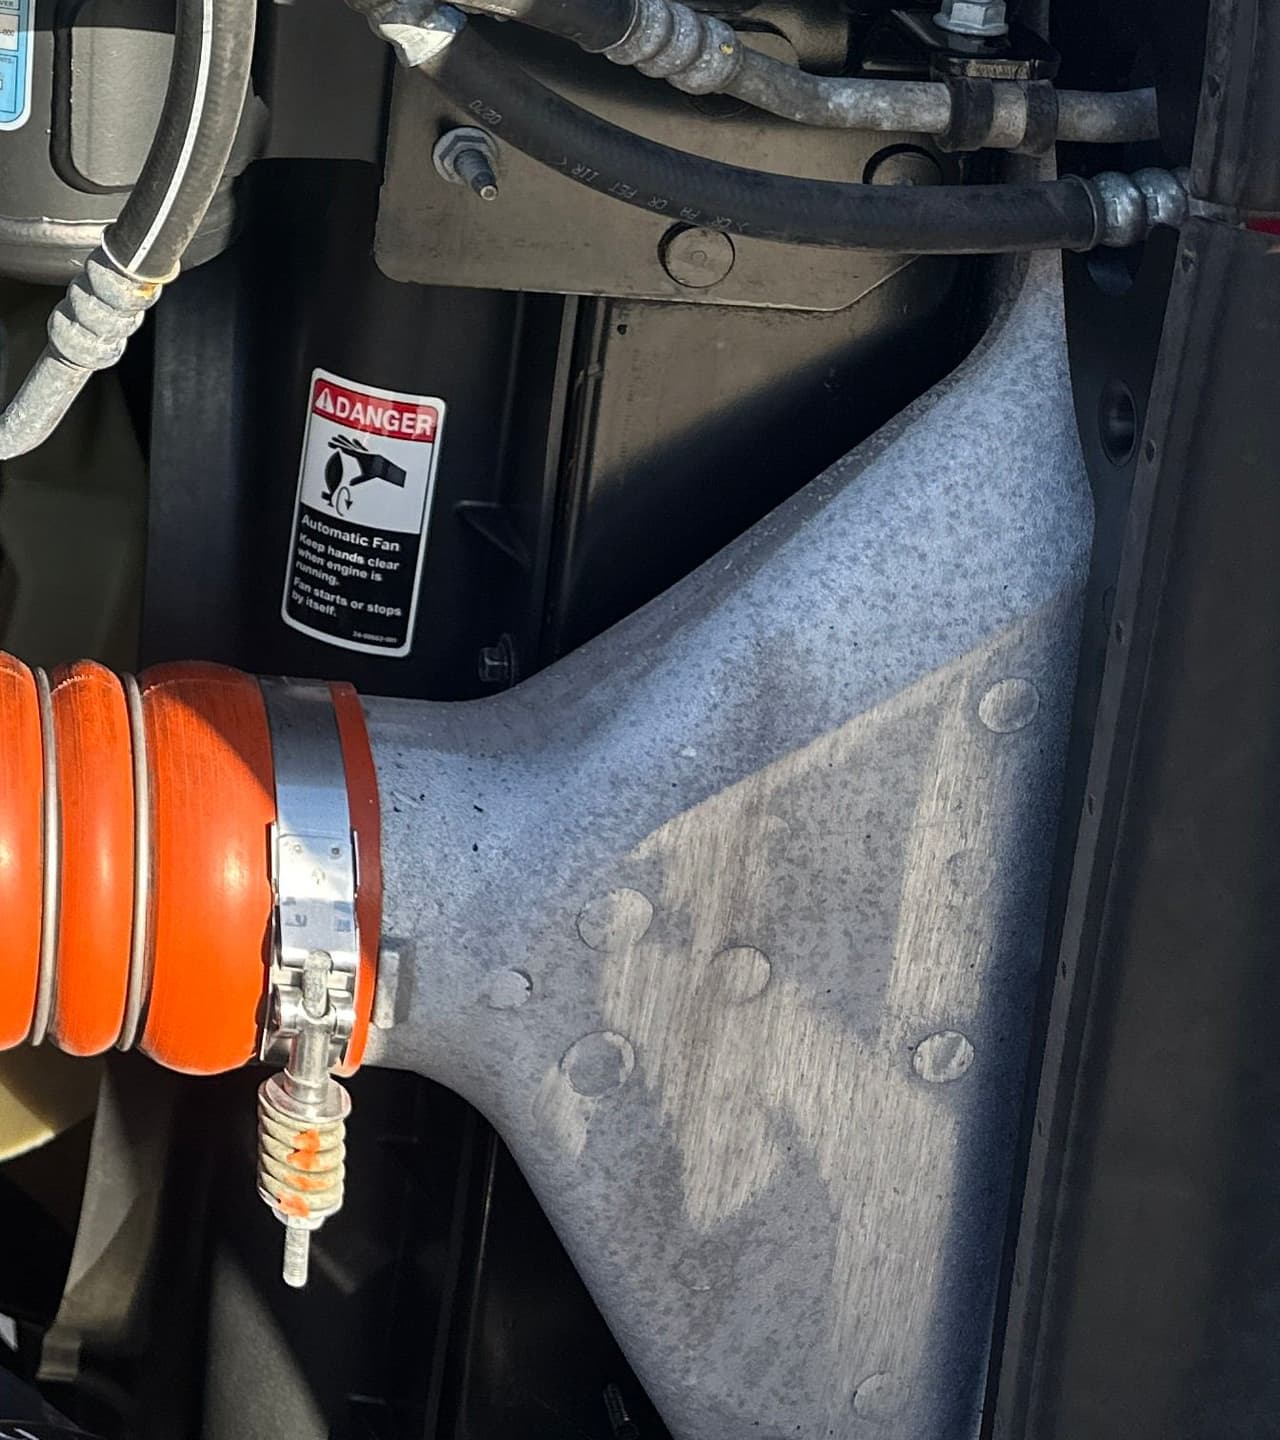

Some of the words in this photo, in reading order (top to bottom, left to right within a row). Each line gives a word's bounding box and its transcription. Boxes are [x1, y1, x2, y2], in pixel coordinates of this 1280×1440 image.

[335, 395, 434, 437] DANGER
[298, 532, 326, 554] Keep
[327, 545, 365, 565] hands
[367, 556, 401, 572] clear
[301, 512, 370, 549] Automatic
[372, 537, 401, 553] Fan
[295, 561, 340, 587] running.
[297, 547, 326, 567] when
[327, 560, 369, 581] engine
[370, 568, 383, 583] is
[291, 590, 304, 608] by
[305, 595, 338, 618] itself.
[293, 576, 313, 594] Fan
[313, 587, 349, 607] starts
[350, 597, 365, 610] or
[366, 600, 403, 618] stops
